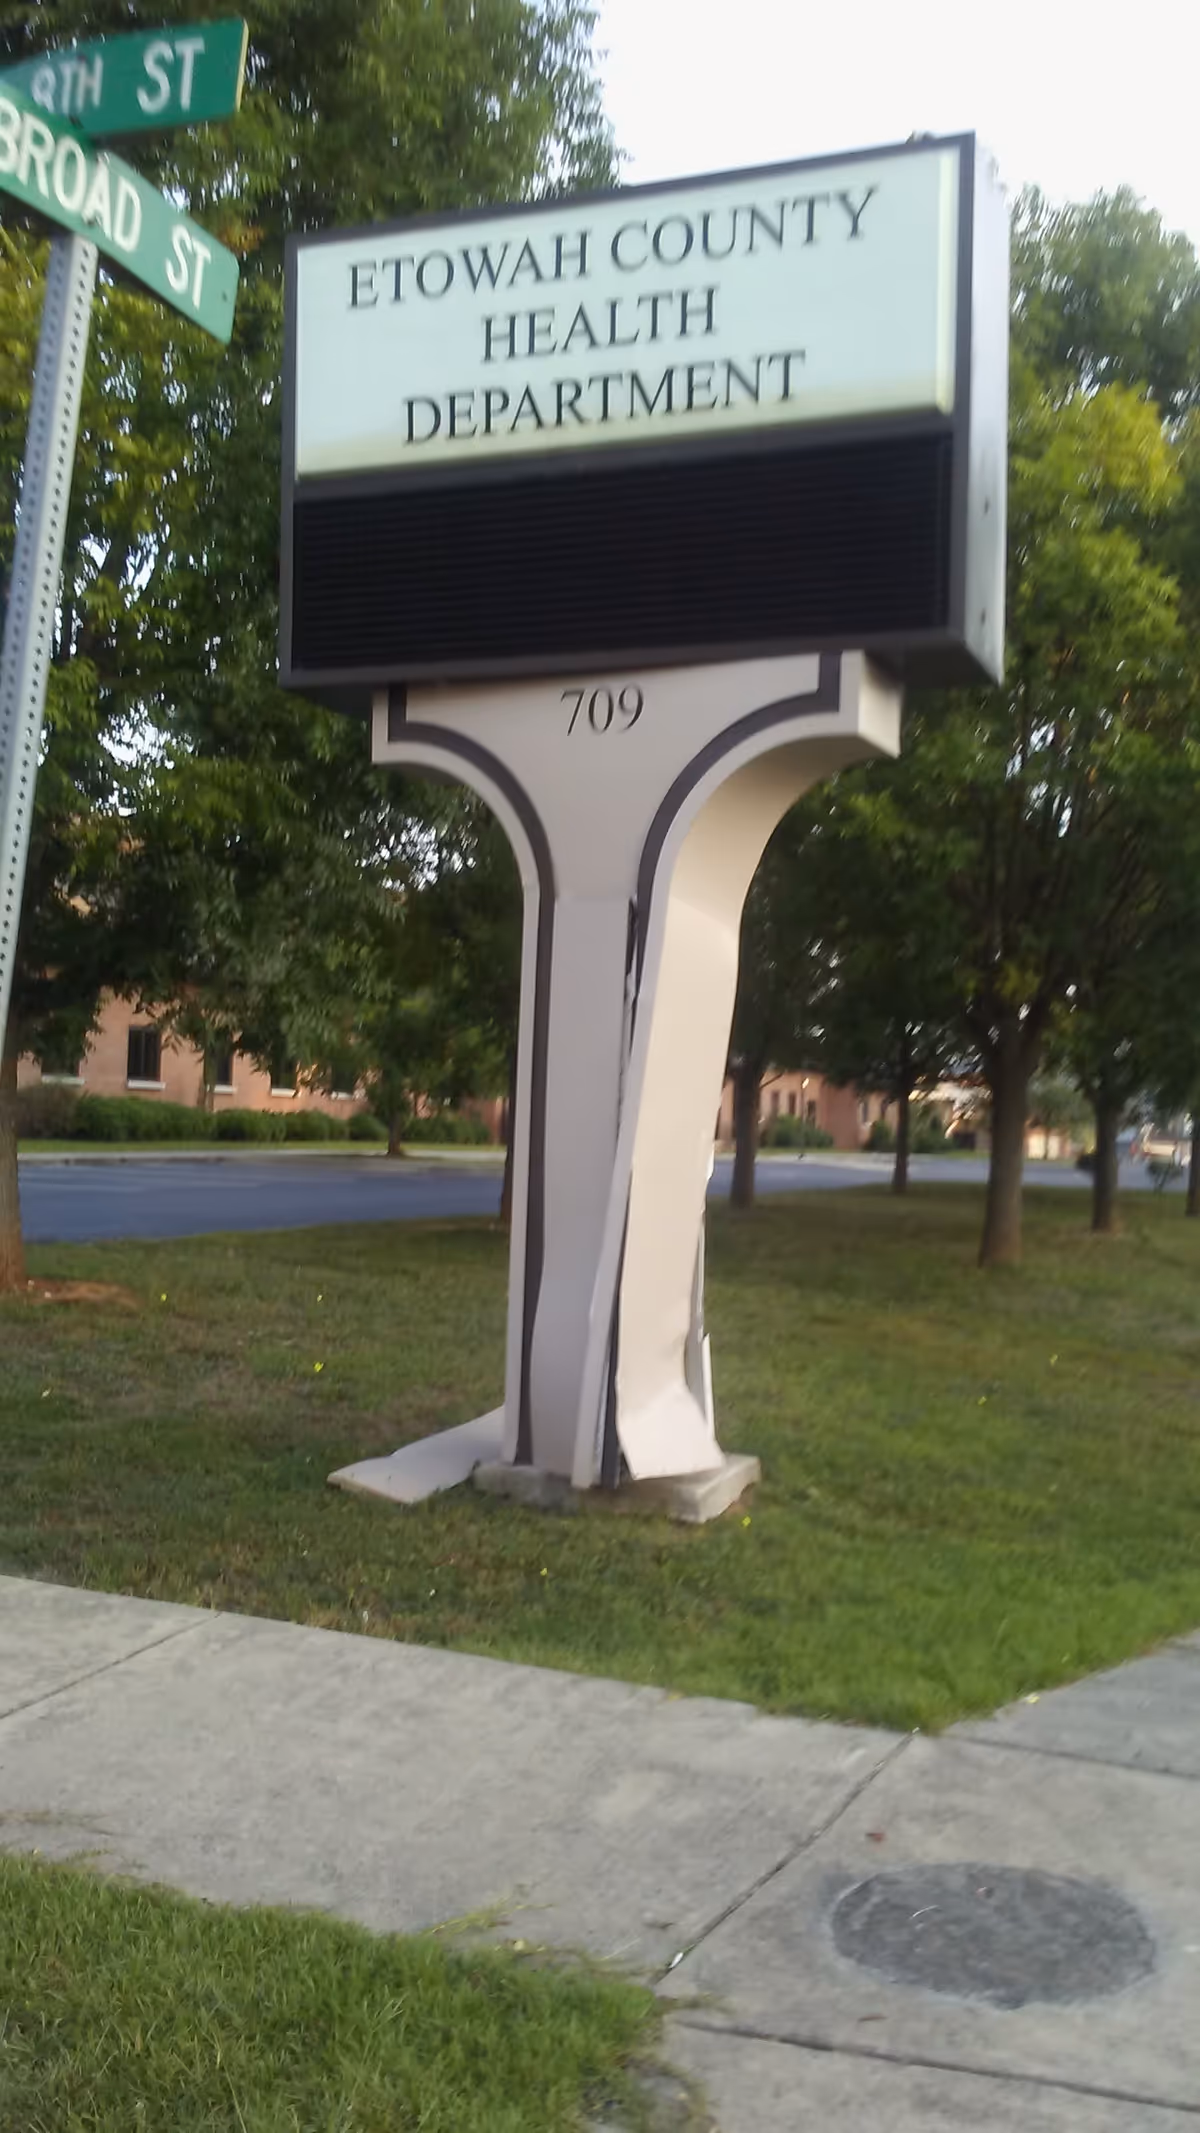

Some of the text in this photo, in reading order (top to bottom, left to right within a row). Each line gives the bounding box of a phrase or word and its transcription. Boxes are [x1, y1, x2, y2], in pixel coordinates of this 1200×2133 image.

[136, 37, 204, 114] ST
[0, 96, 212, 310] BROAD ST
[347, 184, 880, 309] ETOWAH COUNTY
[480, 285, 719, 364] HEALTH
[402, 350, 806, 445] DEPARTMENT
[560, 682, 645, 736] 709
